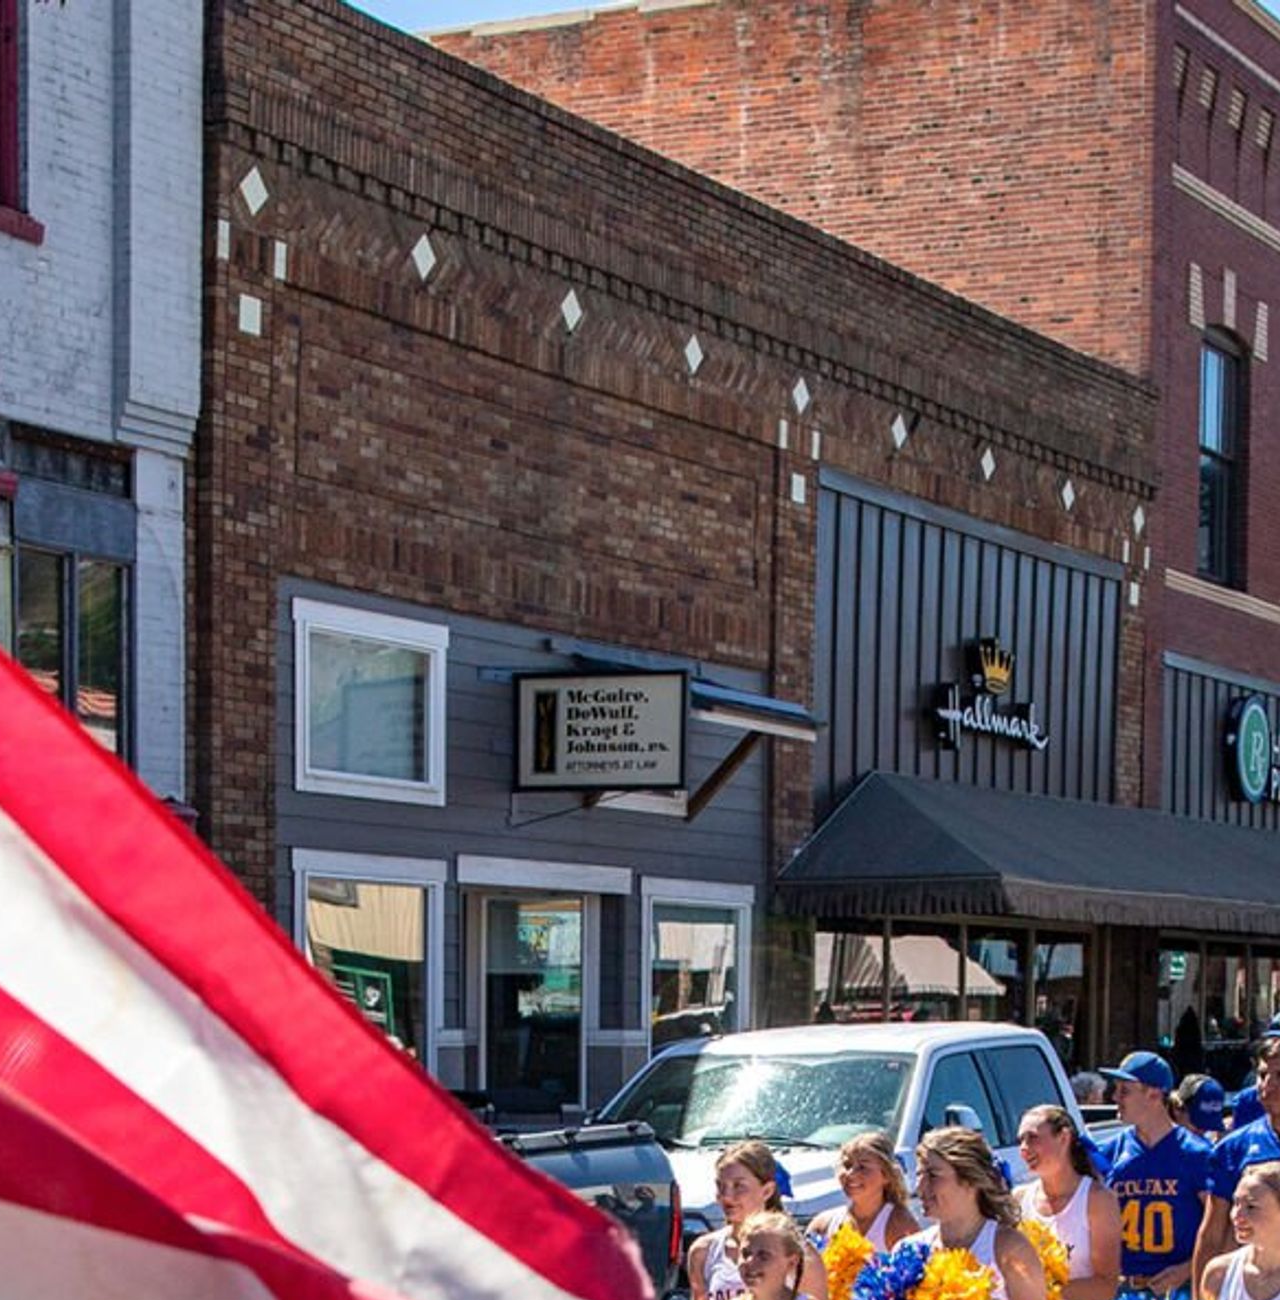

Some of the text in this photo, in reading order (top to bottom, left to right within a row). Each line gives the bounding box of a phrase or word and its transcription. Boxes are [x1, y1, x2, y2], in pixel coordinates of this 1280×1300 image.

[567, 688, 649, 704] McGuire,
[936, 684, 1050, 750] Hallmark
[567, 723, 618, 740] Kragt
[567, 740, 645, 754] Johnson,
[1113, 1178, 1179, 1197] COLFAX
[1122, 1199, 1174, 1254] 40
